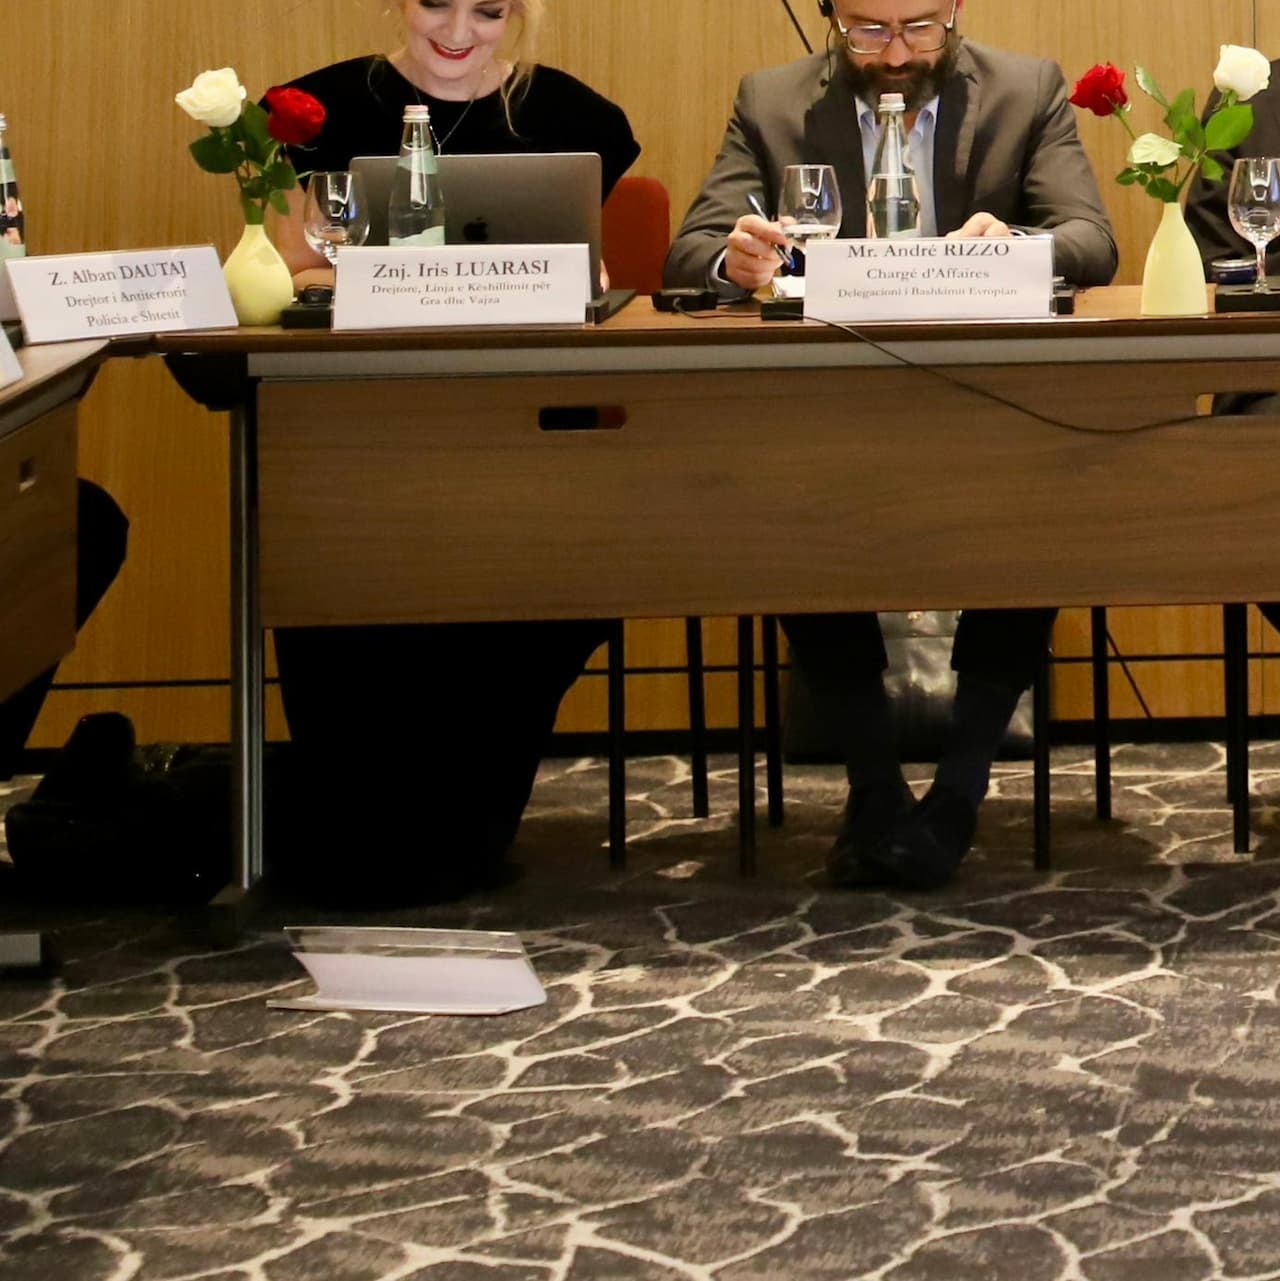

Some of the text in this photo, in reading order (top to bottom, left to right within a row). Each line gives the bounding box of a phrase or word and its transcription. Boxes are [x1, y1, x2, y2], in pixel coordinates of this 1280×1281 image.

[848, 243, 1010, 258] Mr. André RIZZO
[48, 261, 187, 286] Z. Alban DAUTAJ
[372, 260, 550, 281] Znj. Iris LUARASI
[866, 267, 990, 282] Chargé d'Affaires
[371, 284, 421, 296] Drejtore,
[425, 284, 454, 295] Linja
[468, 282, 529, 292] Këshillimit
[532, 282, 551, 293] për
[838, 288, 901, 299] Delegacioni
[969, 287, 1017, 297] Evropian
[64, 294, 109, 308] Drejtor
[120, 287, 187, 303] Antiterrorit
[420, 296, 500, 306] Gra dhe Vajza
[86, 314, 129, 327] Policia
[140, 309, 180, 321] Shtetit
